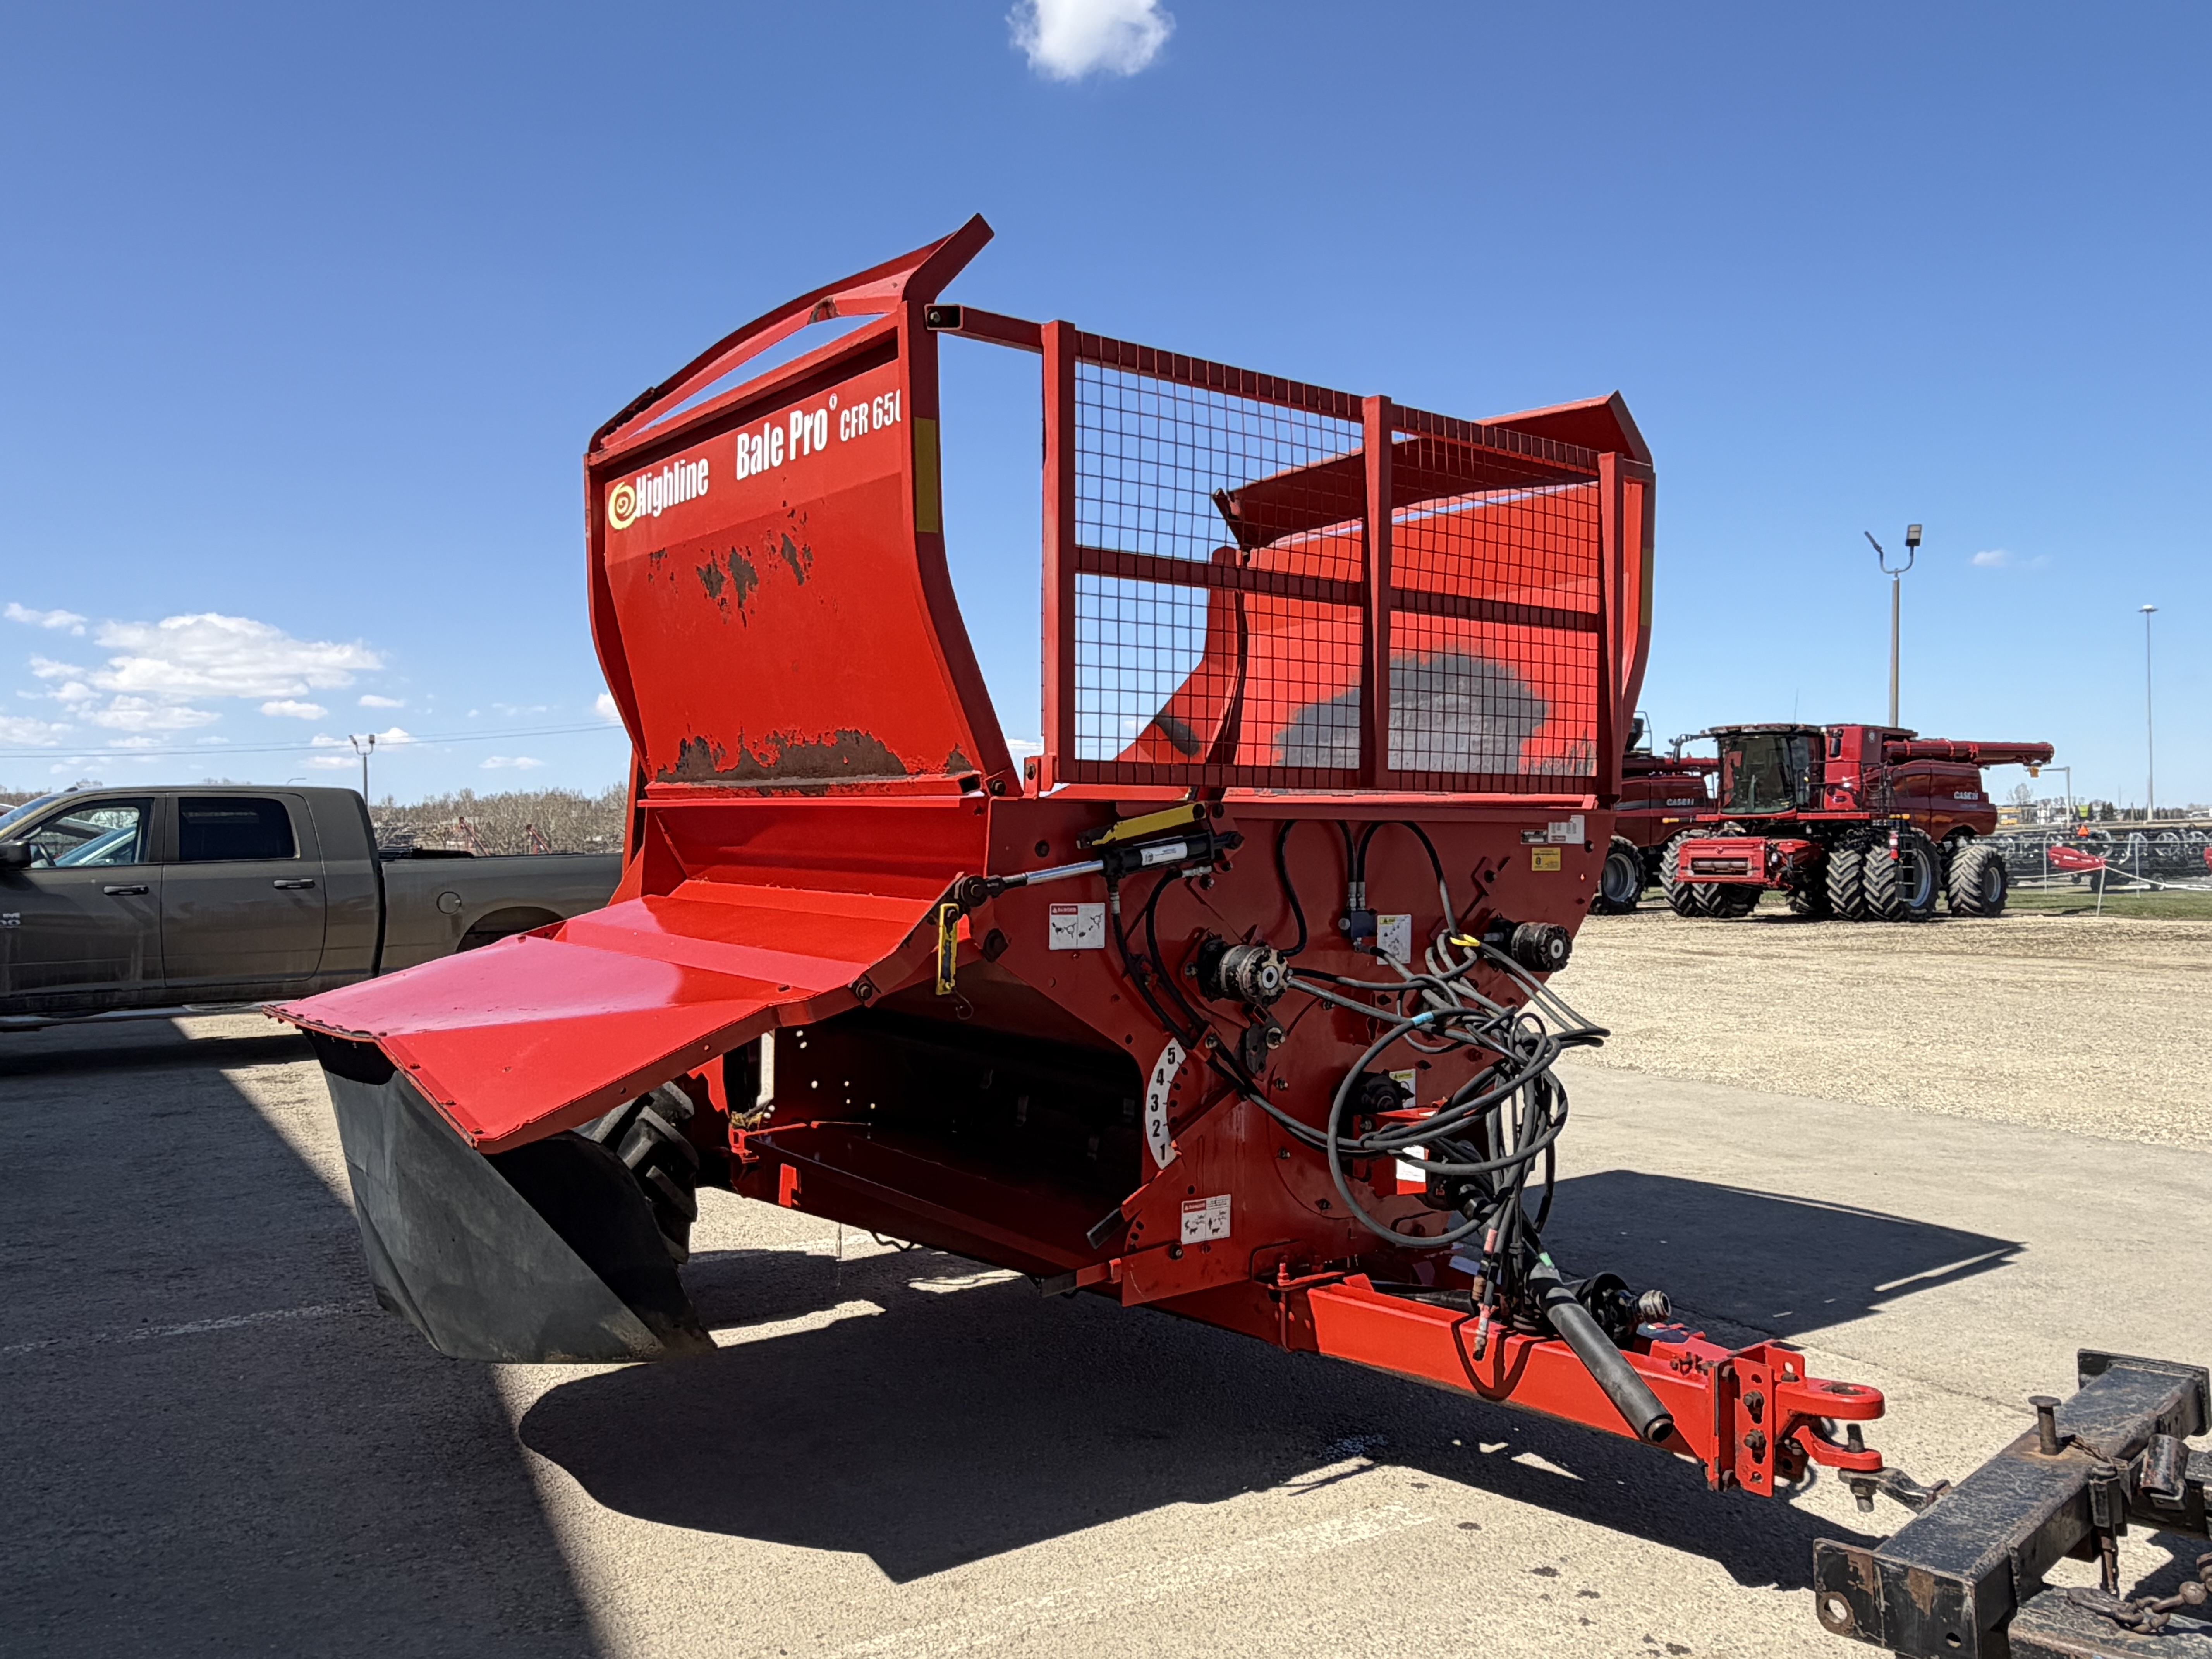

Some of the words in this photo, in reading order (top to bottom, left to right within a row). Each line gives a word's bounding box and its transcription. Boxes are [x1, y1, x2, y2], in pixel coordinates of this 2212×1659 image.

[737, 422, 784, 480] Bale
[789, 408, 828, 461] Pro
[840, 402, 869, 441] CFR
[636, 458, 709, 517] Highline
[1167, 1047, 1176, 1065] 5
[1156, 1068, 1164, 1086] 4
[1151, 1094, 1159, 1112] 3
[1152, 1119, 1160, 1137] 2
[1159, 1143, 1166, 1161] 1
